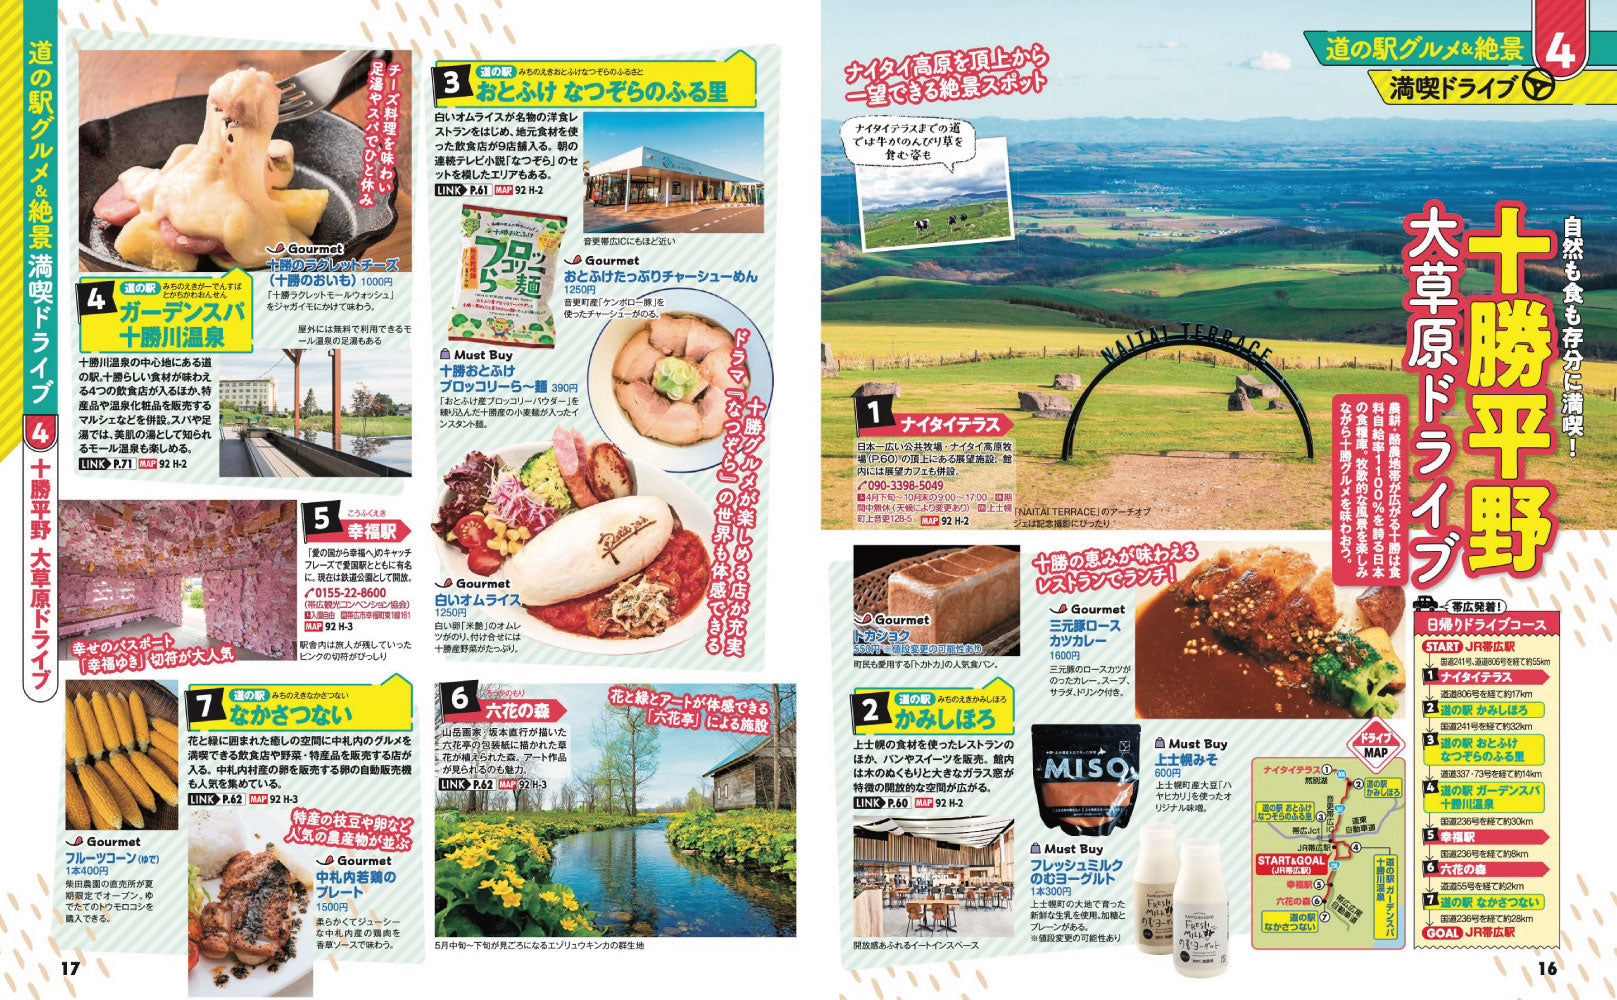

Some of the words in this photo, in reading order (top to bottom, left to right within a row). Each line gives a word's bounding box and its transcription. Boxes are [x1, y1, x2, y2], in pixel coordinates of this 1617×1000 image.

[1545, 32, 1575, 68] 4
[846, 45, 1048, 83] ナイタイ高原を頂上から
[480, 67, 512, 77] 道の駅
[519, 68, 644, 76] みちのえきおとふけなつぞらのふるさと
[444, 71, 460, 93] 3
[1389, 75, 1519, 100] 満喫ドライブ
[476, 81, 557, 102] おとふけ
[563, 81, 729, 102] なつぞらのふる里
[847, 72, 1046, 106] 一望できる絶景スポット
[435, 112, 578, 122] 白いオムライスが名物の洋食レ
[359, 61, 384, 206] 足湯やスパでひと休み
[378, 63, 401, 194] チーズ料理を味わい
[435, 126, 578, 137] ストランをはじめ、地元食材を使
[855, 122, 960, 134] ナイタイテラスまでの道
[853, 136, 962, 147] では牛がのんびり草を
[885, 149, 931, 160] 食む姿も
[435, 155, 578, 166] 連続テレビ小説「なつぞら」のセ
[435, 170, 552, 180] ットを模したエリアもある。
[470, 186, 488, 195] P.61
[288, 243, 343, 254] Gourmet
[266, 258, 400, 272] 十勝のラクレットチーズ
[585, 256, 640, 265] Gourmet
[564, 270, 758, 283] おとふけたっぷりチャーシューめん
[361, 278, 393, 287] 1000円
[124, 283, 156, 294] 道の駅
[565, 285, 596, 294] 1250円
[87, 287, 105, 309] 4
[120, 301, 245, 323] ガーデンスパ
[266, 302, 375, 311] をジャガイモにかけて味わう。
[564, 310, 660, 319] 使ったチャーシューがのる。
[298, 325, 412, 334] 屋外には無料で利用できるモ
[119, 326, 225, 348] 十勝川温泉
[298, 337, 382, 345] ール温泉の足湯もある
[1100, 323, 1168, 364] NAITAI
[1181, 321, 1274, 363] TERRACE
[454, 350, 485, 360] Must
[489, 350, 513, 361] Buy
[78, 357, 212, 368] 十勝川温泉の中心地にある道
[439, 364, 515, 378] 十勝おとふけ
[78, 372, 212, 382] の駅。十勝らしい食材が味わえ
[78, 386, 212, 397] る4つの飲食店が入るほか、特
[552, 383, 578, 392] 390円
[1466, 207, 1552, 573] 十勝平野
[1408, 206, 1461, 584] 大草原ドライブ
[78, 400, 212, 411] 産品や温泉化粧品を販売する
[867, 400, 879, 423] 1
[78, 415, 212, 425] マルシェなどを併設。スパや足
[901, 416, 1001, 433] ナイタイテラス
[31, 422, 50, 443] 4
[78, 430, 212, 440] 湯では、美肌の湯として知られ
[78, 444, 192, 454] るモール温泉も楽しめる。
[113, 459, 132, 469] P.71
[857, 467, 961, 476] 内には展望カフェも併設。
[868, 481, 944, 490] 090-3398-5049
[30, 458, 52, 540] 十勝平野
[314, 507, 329, 529] 5
[347, 523, 398, 540] 幸福駅
[725, 398, 765, 657] 十勝グルメが楽しめる店が充実
[1033, 543, 1198, 574] 十勝の恵みが味わえる
[304, 560, 412, 571] フレーズで愛国駅とともに有名
[456, 579, 511, 589] Gourmet
[315, 587, 386, 598] 0155-22-8600
[435, 594, 521, 607] 白いオムライス
[435, 608, 467, 618] 1250円
[1071, 605, 1126, 615] Gourmet
[30, 547, 53, 690] 大草原ドライブ
[875, 615, 930, 625] Gourmet
[1049, 619, 1121, 632] 三元豚ロース
[1427, 618, 1547, 632] 日帰りドライブコース
[854, 629, 910, 642] トカショク
[1049, 634, 1107, 647] カツカレー
[72, 635, 172, 656] 幸せのパスポート
[1465, 641, 1515, 652] JR帯広駅
[1050, 651, 1080, 660] 1600円
[1049, 665, 1131, 674] 三元豚のロースカツが
[1440, 672, 1513, 683] ナイタイテラス
[233, 690, 266, 701] 道の駅
[451, 686, 469, 709] 6
[899, 694, 931, 704] 道の駅
[196, 694, 212, 717] 7
[611, 688, 769, 715] 花と緑とアートが体感できる
[229, 704, 353, 726] なかさつない
[485, 702, 550, 719] 六花の森
[862, 698, 879, 721] 2
[1476, 705, 1528, 715] かみしほろ
[894, 708, 996, 730] かみしほろ
[442, 727, 567, 738] 山岳画家・坂本直行が描いた
[1361, 732, 1392, 744] ドライブ
[187, 736, 412, 746] 花と緑に囲まれた癒しの空間に中札内のグルメを
[442, 741, 567, 750] 六花亭の包装紙に描かれた草
[853, 740, 1014, 750] 上士幌の食材を使ったレストランの
[1168, 739, 1200, 749] Must
[1203, 739, 1228, 750] Buy
[1477, 738, 1518, 748] おとふけ
[187, 750, 412, 761] 満喫できる飲食店や野菜・特産品を販売する店が
[442, 753, 567, 762] 花が植えられた森。アート作品
[1364, 747, 1388, 758] MAP
[1441, 751, 1524, 762] なつぞらのふる里
[853, 754, 1014, 764] ほか、パンやスイーツを販売。館内
[1154, 753, 1218, 767] 上士幌みそ
[187, 765, 412, 775] 入る。中札内村産の卵を販売する卵の自動販売機
[442, 765, 526, 775] が見られるのも魅力。
[853, 768, 1014, 778] は木のぬくもりと大きなガラス窓が
[1044, 757, 1129, 779] MISO
[1154, 768, 1181, 778] 600円
[1263, 766, 1320, 775] ナイタイテラス
[187, 779, 282, 789] も人気を集めている。
[473, 780, 493, 789] P.62
[853, 783, 991, 793] 特徴の開放的な空間が広がる。
[1477, 785, 1540, 796] ガーデンスパ
[222, 795, 243, 804] P.62
[887, 798, 908, 808] P.60
[1440, 798, 1494, 810] 十勝川温泉
[294, 809, 413, 834] 特産の枝豆や卵など
[87, 837, 141, 847] Gourmet
[286, 826, 412, 850] 人気の農産物が並ぶ
[1044, 844, 1076, 854] Must
[1079, 844, 1103, 856] Buy
[65, 852, 137, 865] フルーツコーン
[337, 856, 391, 866] Gourmet
[1258, 856, 1325, 865] START&GOAL
[65, 866, 109, 876] 1本400円
[1030, 859, 1123, 872] フレッシュミルク
[1440, 864, 1487, 875] 六花の森
[316, 870, 396, 884] 中札内若鶏の
[1030, 872, 1116, 885] のむヨーグルト
[65, 891, 154, 900] 期限定でオープン。ゆ
[316, 886, 364, 899] プレート
[1031, 887, 1072, 897] 1本300円
[65, 903, 154, 912] でたてのトウモロコシを
[316, 903, 348, 912] 1500円
[1477, 896, 1540, 908] なかさつない
[316, 918, 401, 927] 柔らかくてジューシー
[1030, 923, 1088, 932] プレーンがある。
[1465, 927, 1515, 938] JR帯広駅
[316, 940, 394, 949] 香草ソースで味わう。
[854, 941, 980, 950] 開放感あふれるイートインスペース
[61, 961, 81, 976] 17
[1539, 962, 1557, 976] 16
